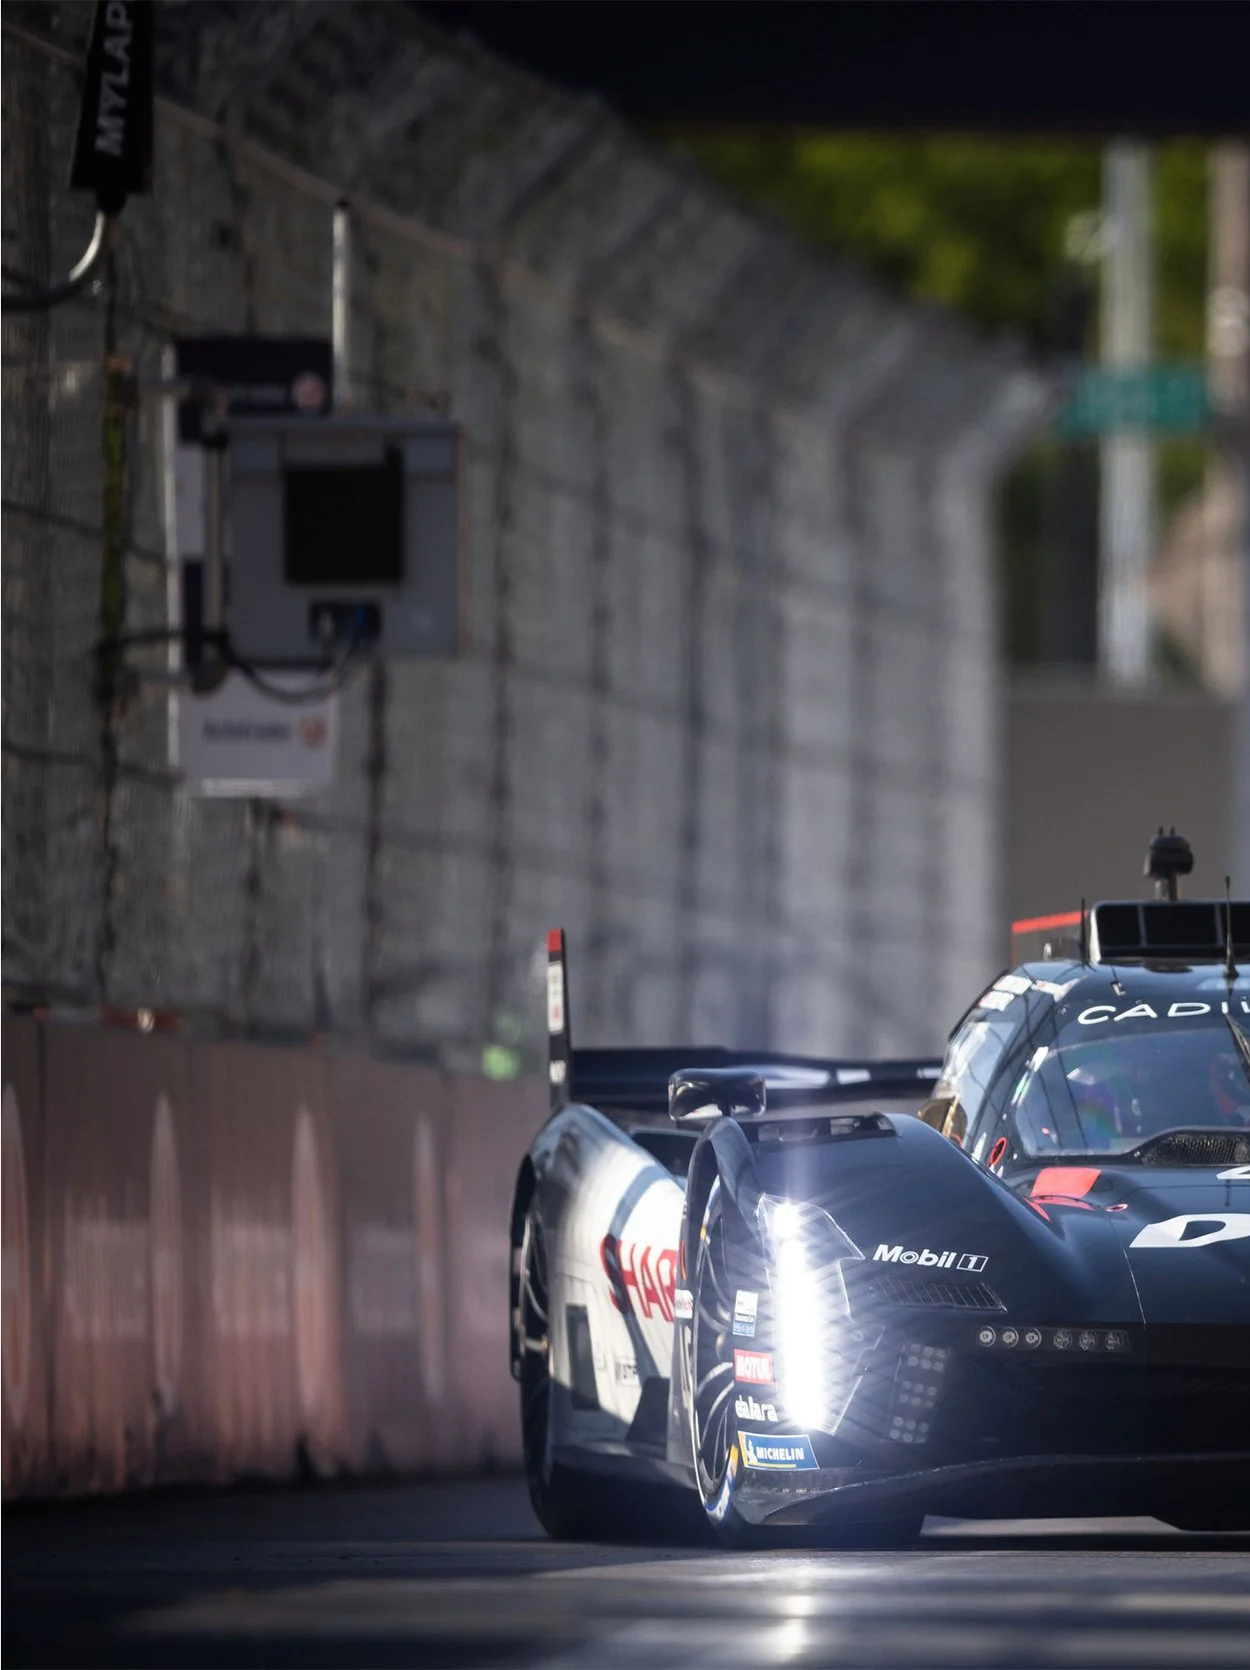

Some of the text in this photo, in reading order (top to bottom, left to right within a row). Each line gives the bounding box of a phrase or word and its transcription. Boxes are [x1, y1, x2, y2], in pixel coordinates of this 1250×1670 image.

[872, 1243, 957, 1269] Mobil
[735, 1354, 773, 1381] MOTUL
[755, 1446, 805, 1461] MICHELIN
